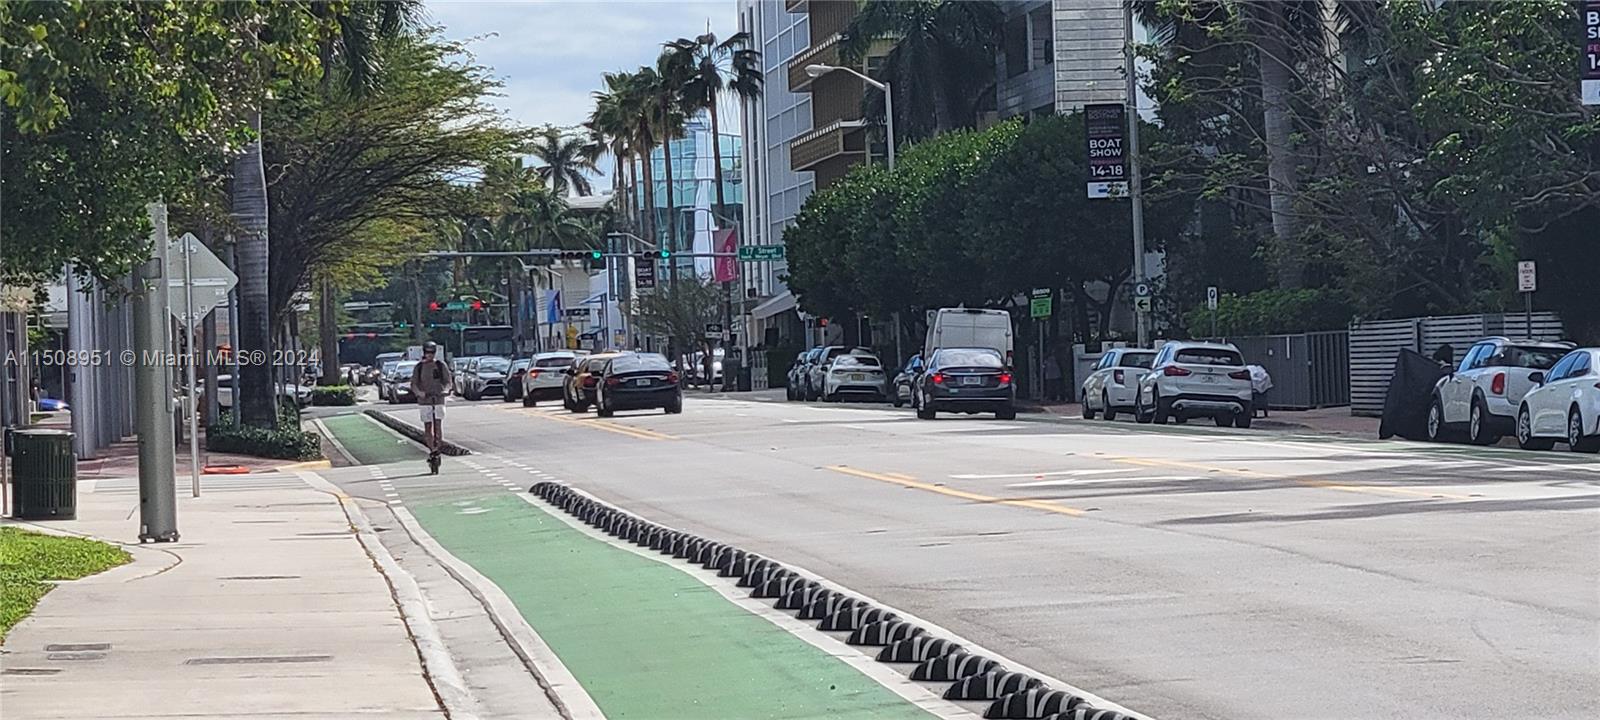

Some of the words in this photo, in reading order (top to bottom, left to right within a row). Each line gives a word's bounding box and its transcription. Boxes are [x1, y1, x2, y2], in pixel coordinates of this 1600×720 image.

[1089, 139, 1122, 149] BOAT
[1090, 148, 1122, 157] SHOW
[1091, 165, 1124, 177] 14-18
[745, 247, 754, 256] 17
